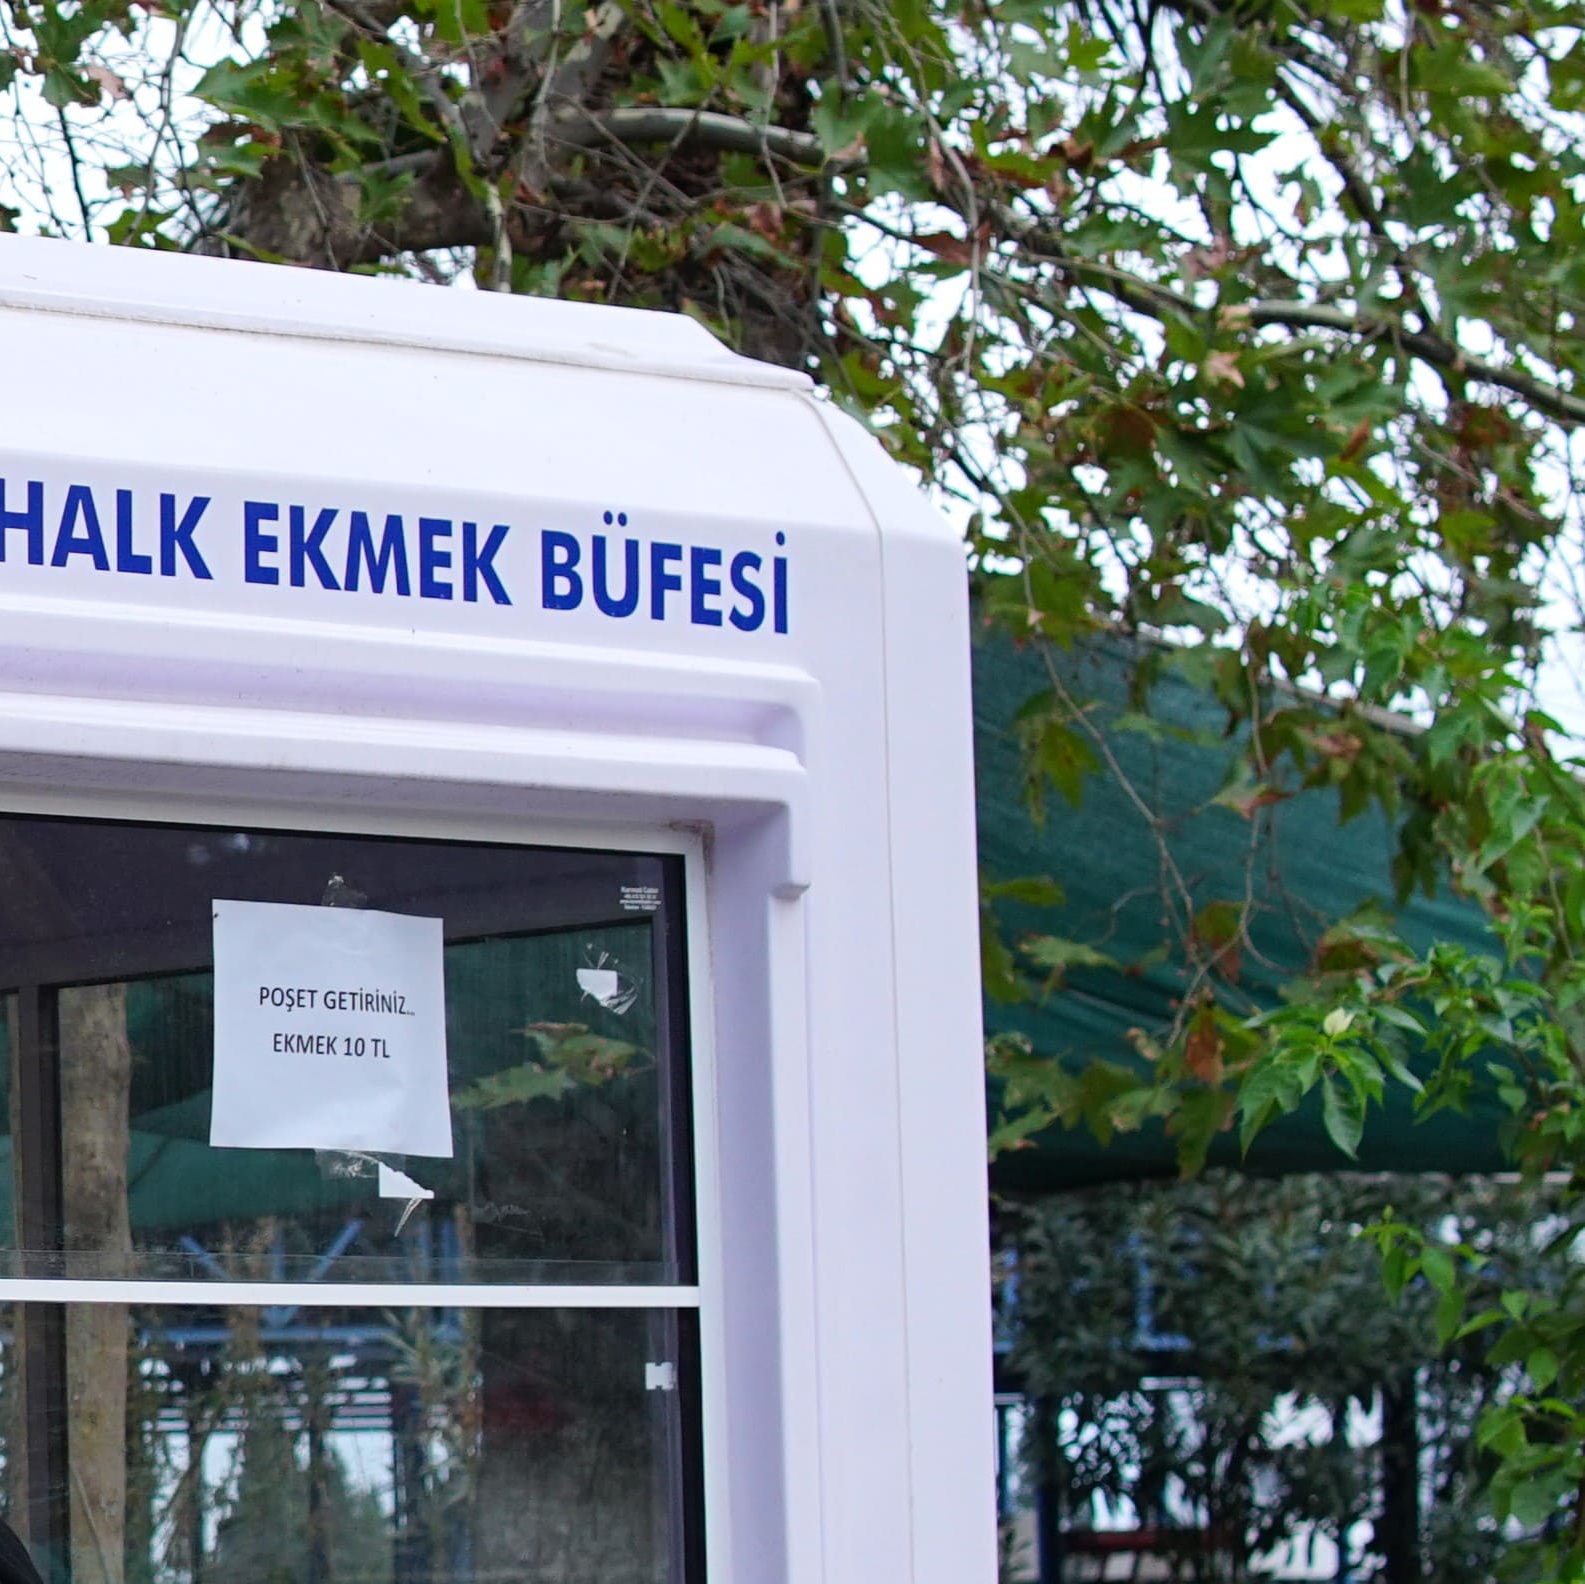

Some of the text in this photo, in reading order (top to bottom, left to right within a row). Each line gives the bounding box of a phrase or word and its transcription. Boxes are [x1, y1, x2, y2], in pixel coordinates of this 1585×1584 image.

[244, 501, 512, 606] EKMEK
[542, 510, 789, 635] BÜFESİ
[259, 986, 318, 1012] POŞET
[272, 1033, 391, 1059] EKMEK 10 TL
